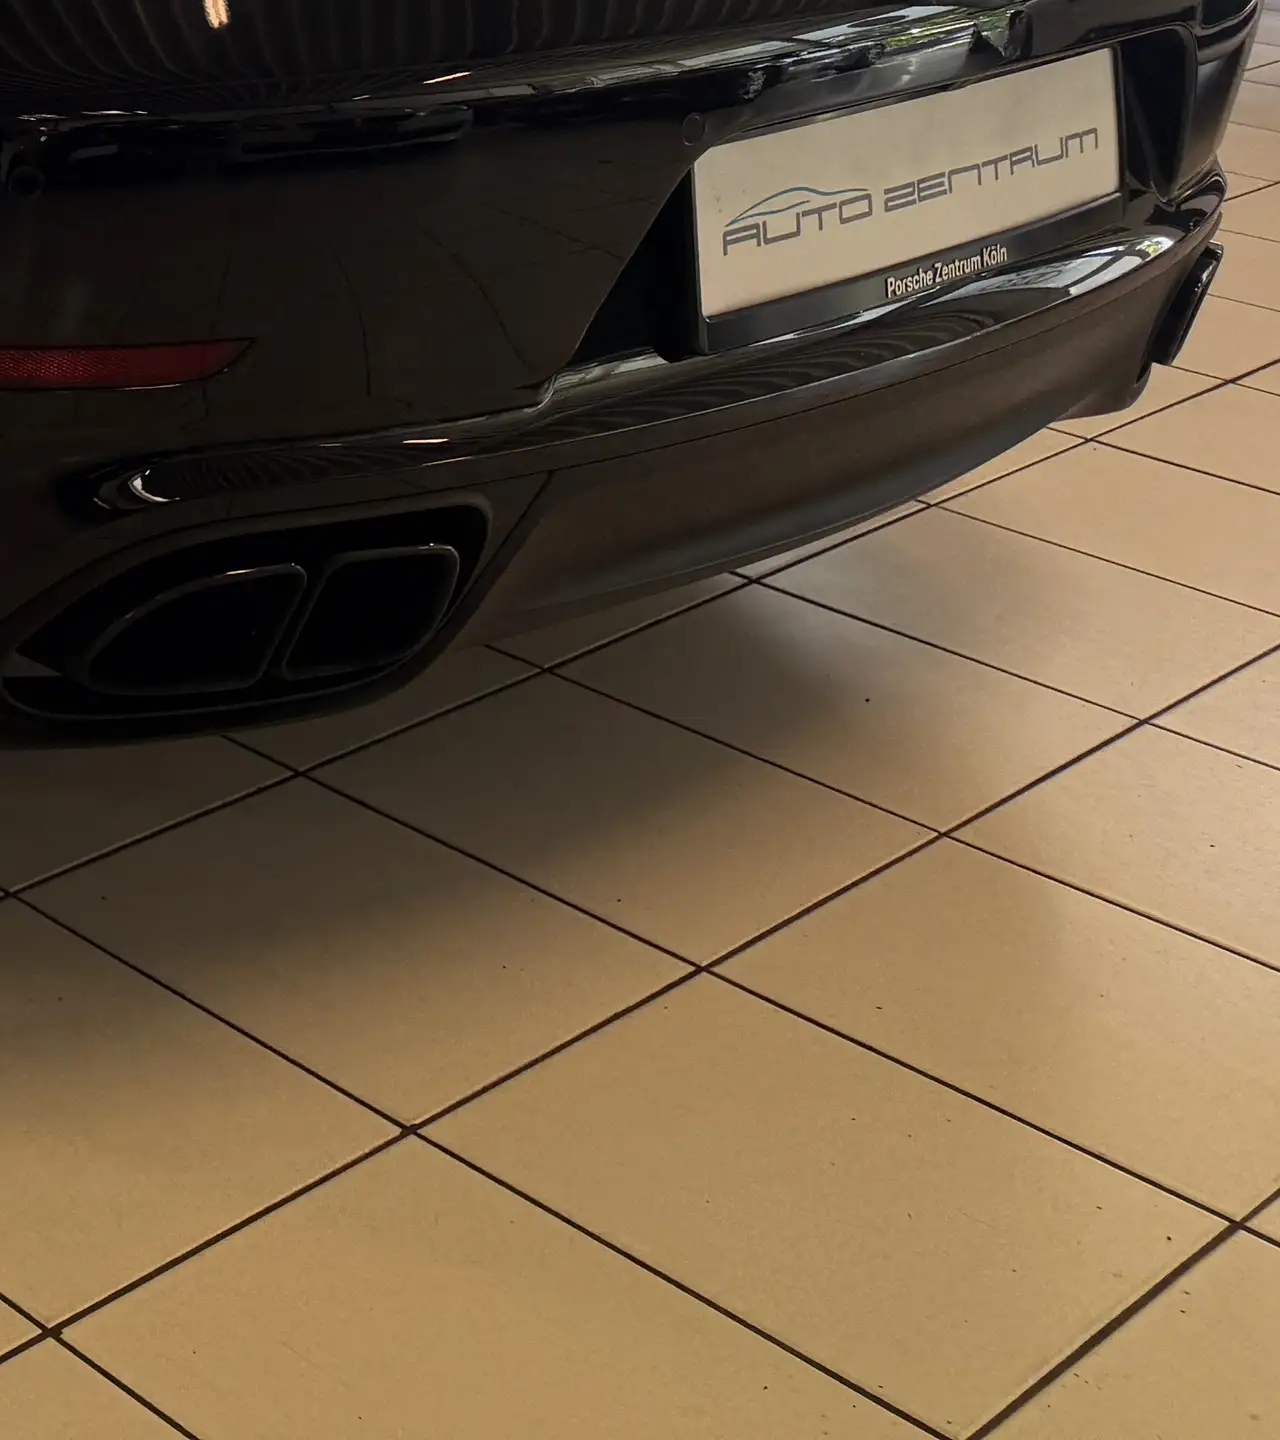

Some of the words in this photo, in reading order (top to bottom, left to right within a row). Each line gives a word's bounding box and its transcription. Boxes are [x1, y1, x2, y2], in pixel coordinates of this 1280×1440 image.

[722, 192, 873, 256] AUTO
[883, 127, 1099, 213] ZENTRUM
[886, 265, 934, 299] Porsche
[934, 256, 982, 283] Zentrum
[982, 243, 1008, 270] Köln
